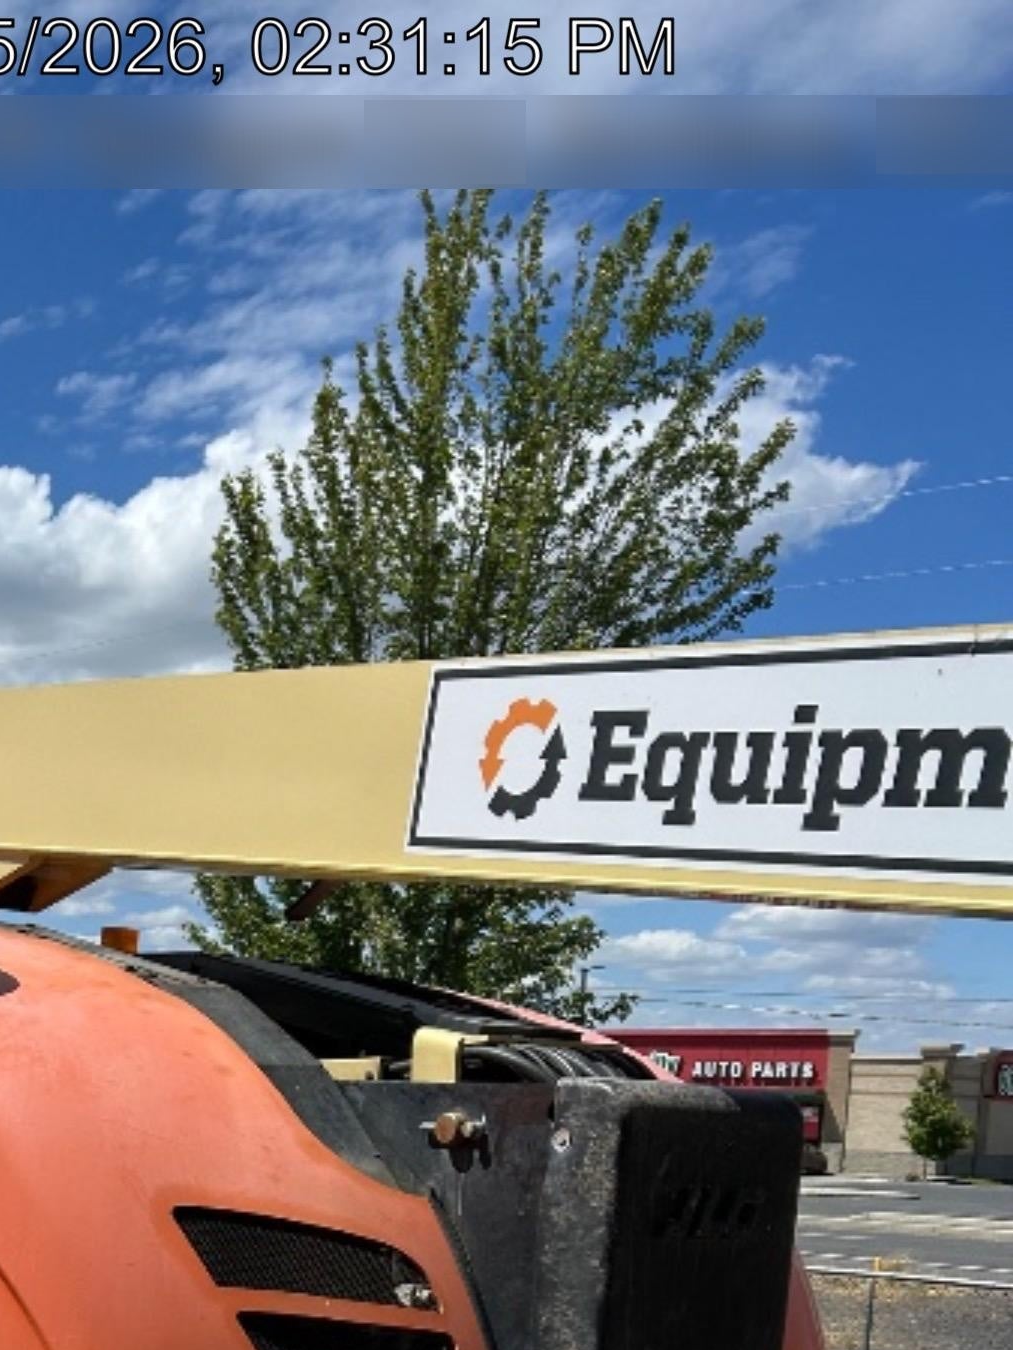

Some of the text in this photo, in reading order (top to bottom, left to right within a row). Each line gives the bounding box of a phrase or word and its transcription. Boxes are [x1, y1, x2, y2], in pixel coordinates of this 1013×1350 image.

[578, 703, 1013, 831] Equipm
[692, 1061, 744, 1078] AUTO
[751, 1061, 814, 1079] PARTS
